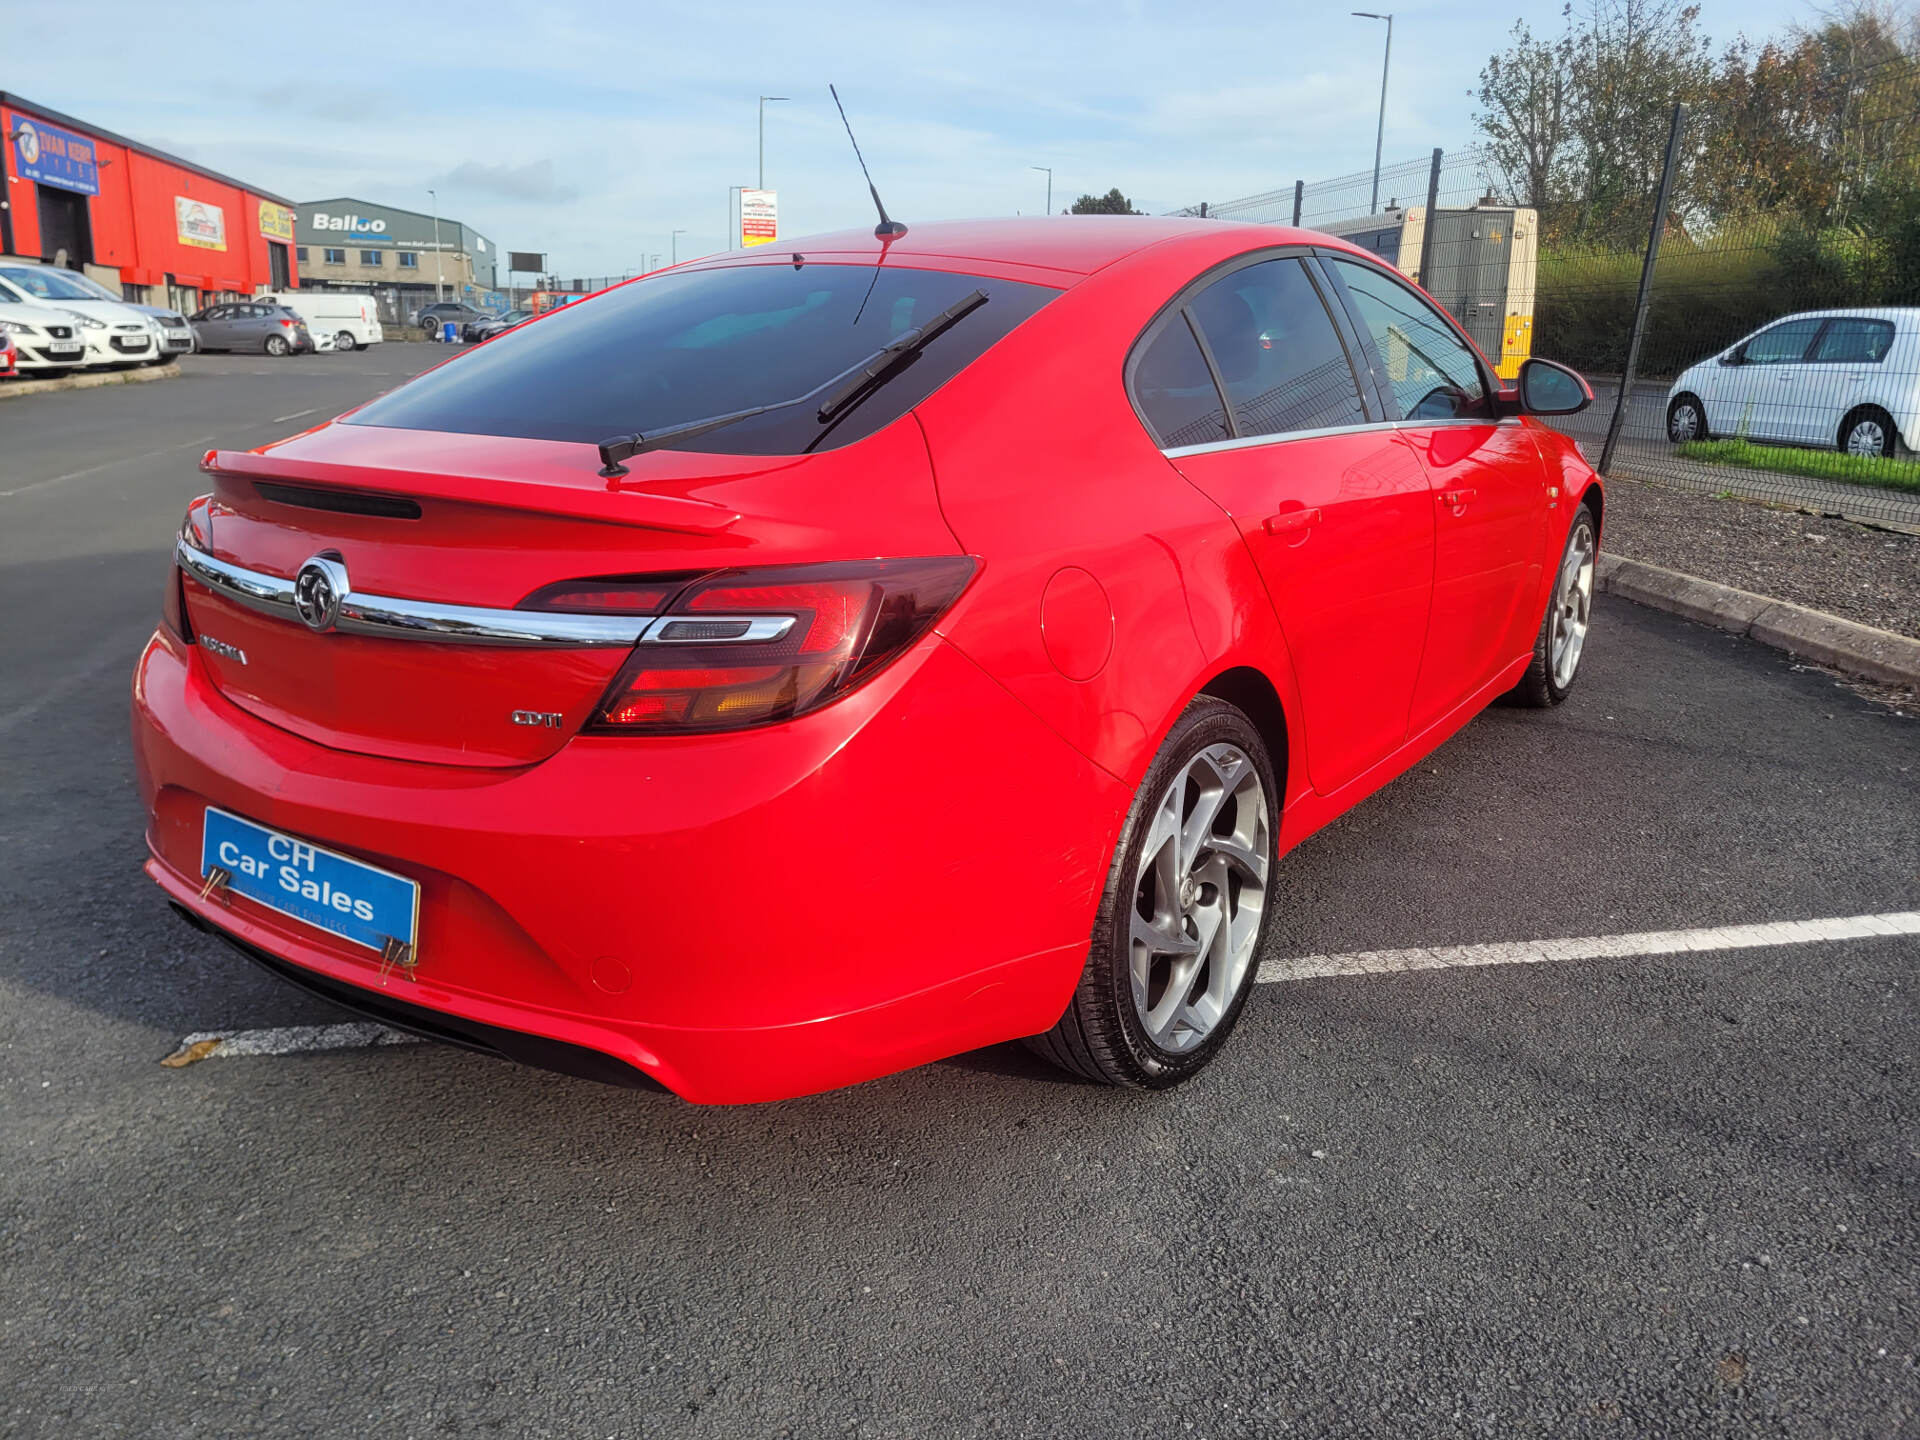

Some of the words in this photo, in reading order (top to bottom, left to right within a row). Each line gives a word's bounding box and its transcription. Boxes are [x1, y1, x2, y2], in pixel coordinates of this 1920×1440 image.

[312, 213, 386, 233] Balloo
[267, 836, 315, 872] CH
[219, 841, 270, 880] Car
[279, 865, 374, 921] Sales
